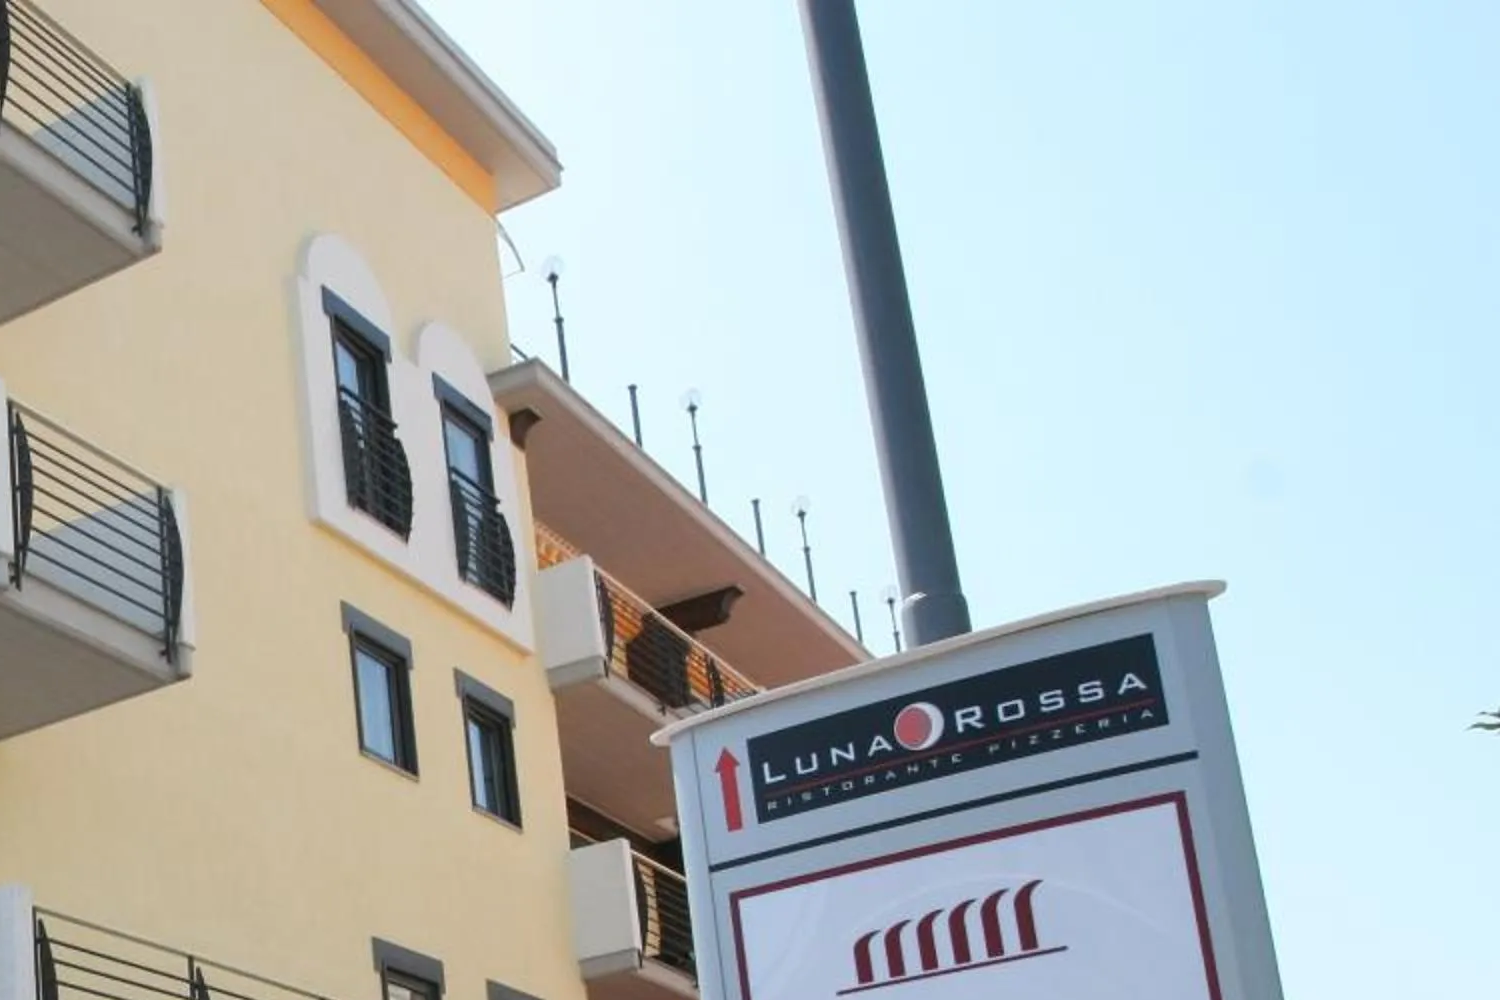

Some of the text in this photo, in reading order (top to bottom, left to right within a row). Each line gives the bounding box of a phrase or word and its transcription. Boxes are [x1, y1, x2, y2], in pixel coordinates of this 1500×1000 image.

[762, 672, 1148, 785] LUNA ROSSA
[766, 708, 1154, 811] RISTORANTE PIZZERIA
